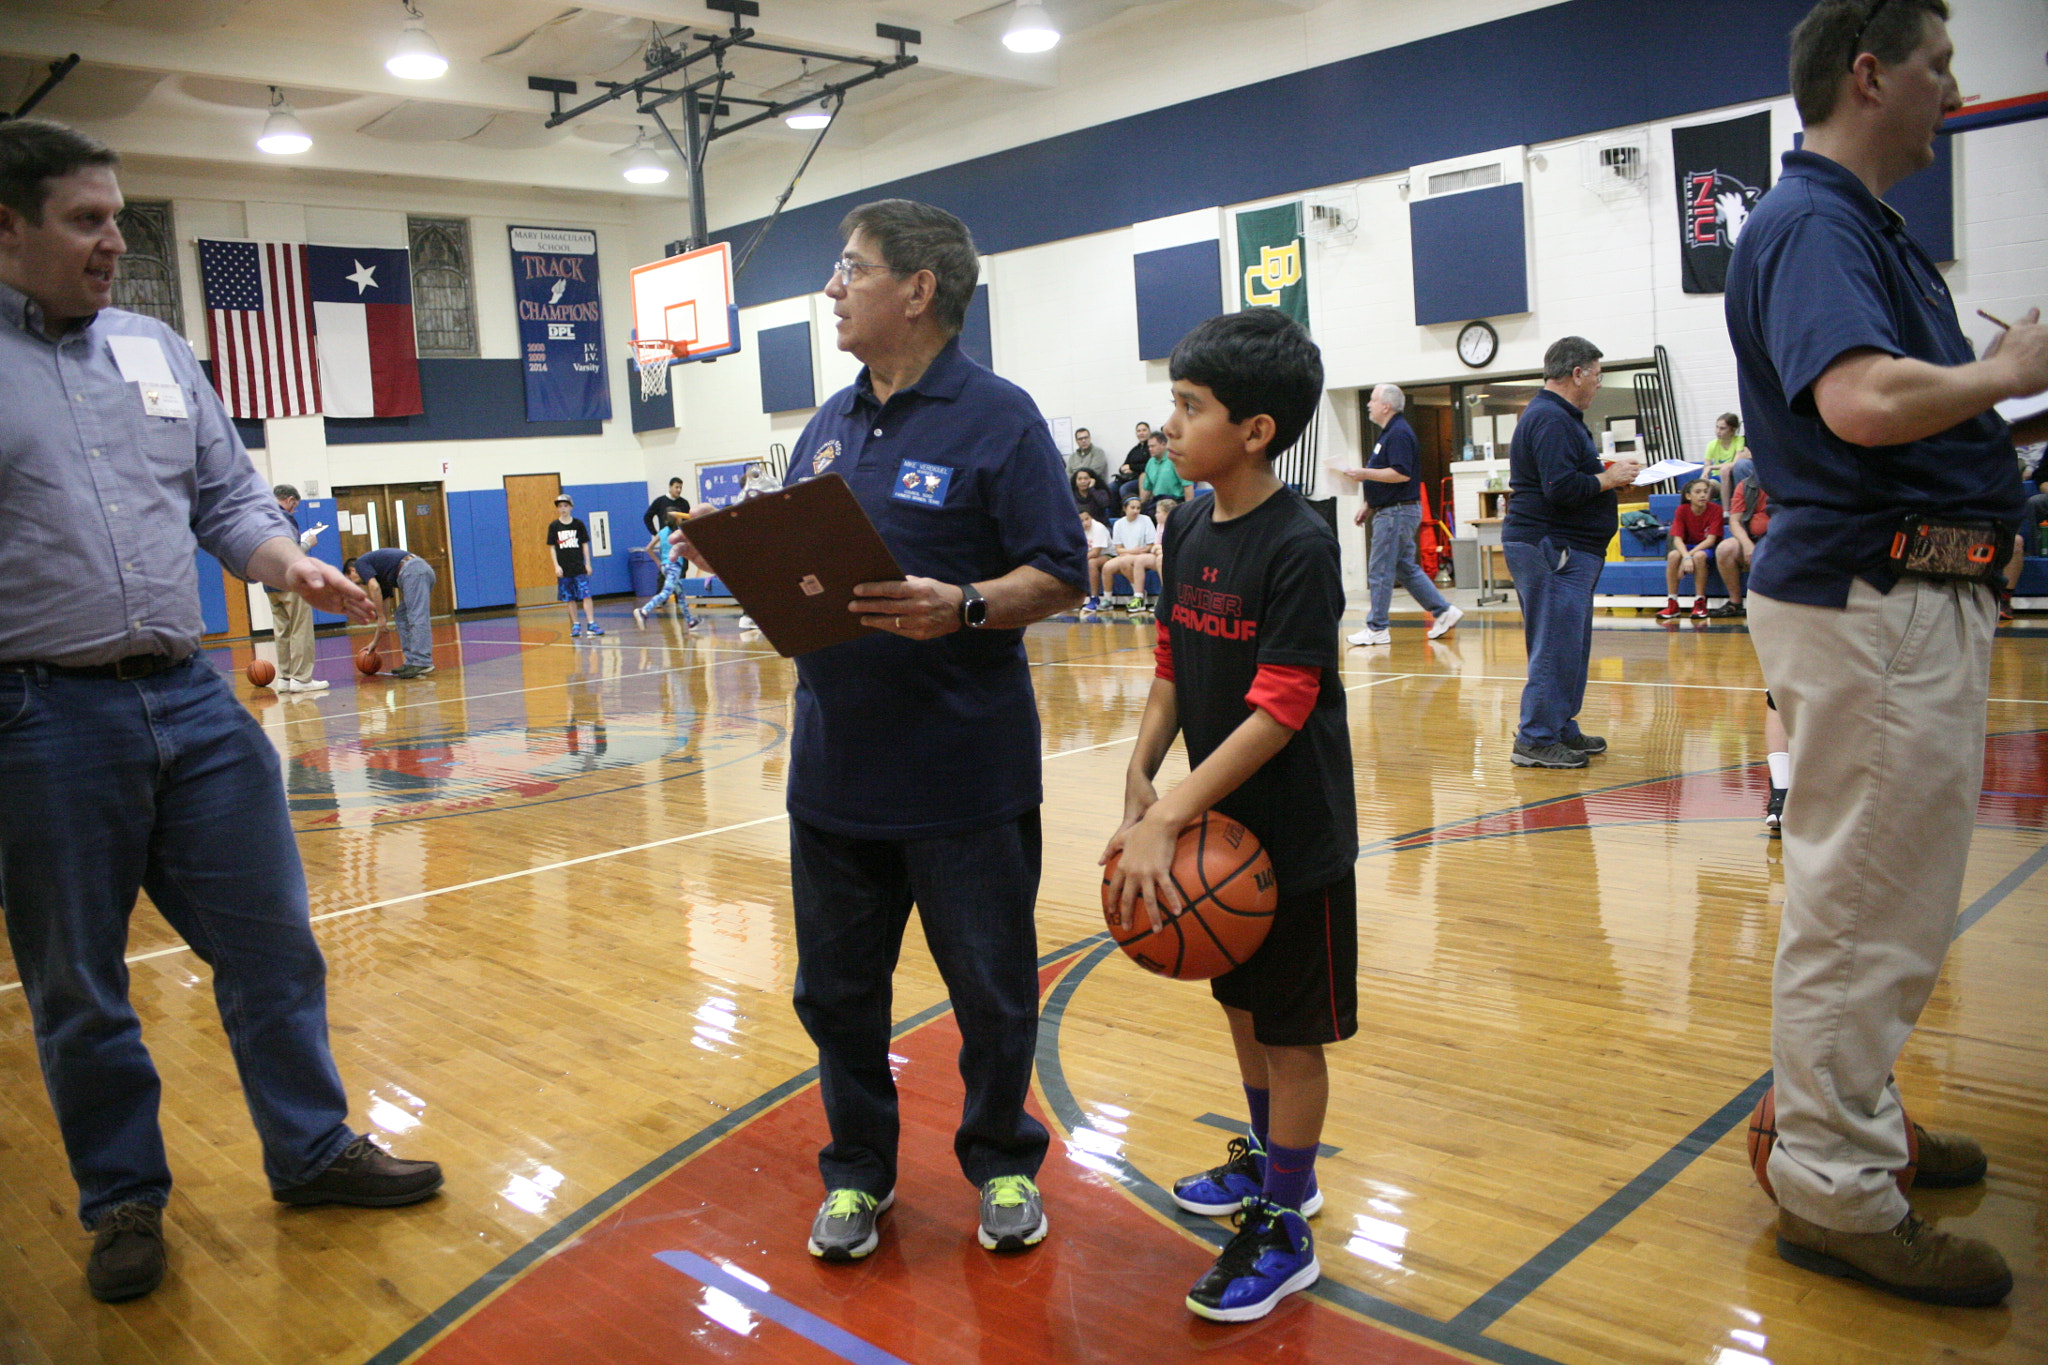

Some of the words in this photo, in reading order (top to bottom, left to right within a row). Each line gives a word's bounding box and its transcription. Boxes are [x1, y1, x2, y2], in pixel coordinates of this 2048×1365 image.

[1692, 175, 1716, 242] NIU
[514, 230, 539, 240] MARY
[540, 231, 592, 243] IMMACULATE
[537, 242, 570, 252] SCHOOL
[521, 255, 586, 282] TRACK
[1244, 238, 1302, 307] BU
[519, 299, 599, 322] CHAMPIONS
[529, 362, 548, 372] 2014
[573, 363, 600, 374] Varsity
[442, 462, 449, 474] F
[557, 529, 577, 541] NEW
[1177, 583, 1242, 618] UNDER
